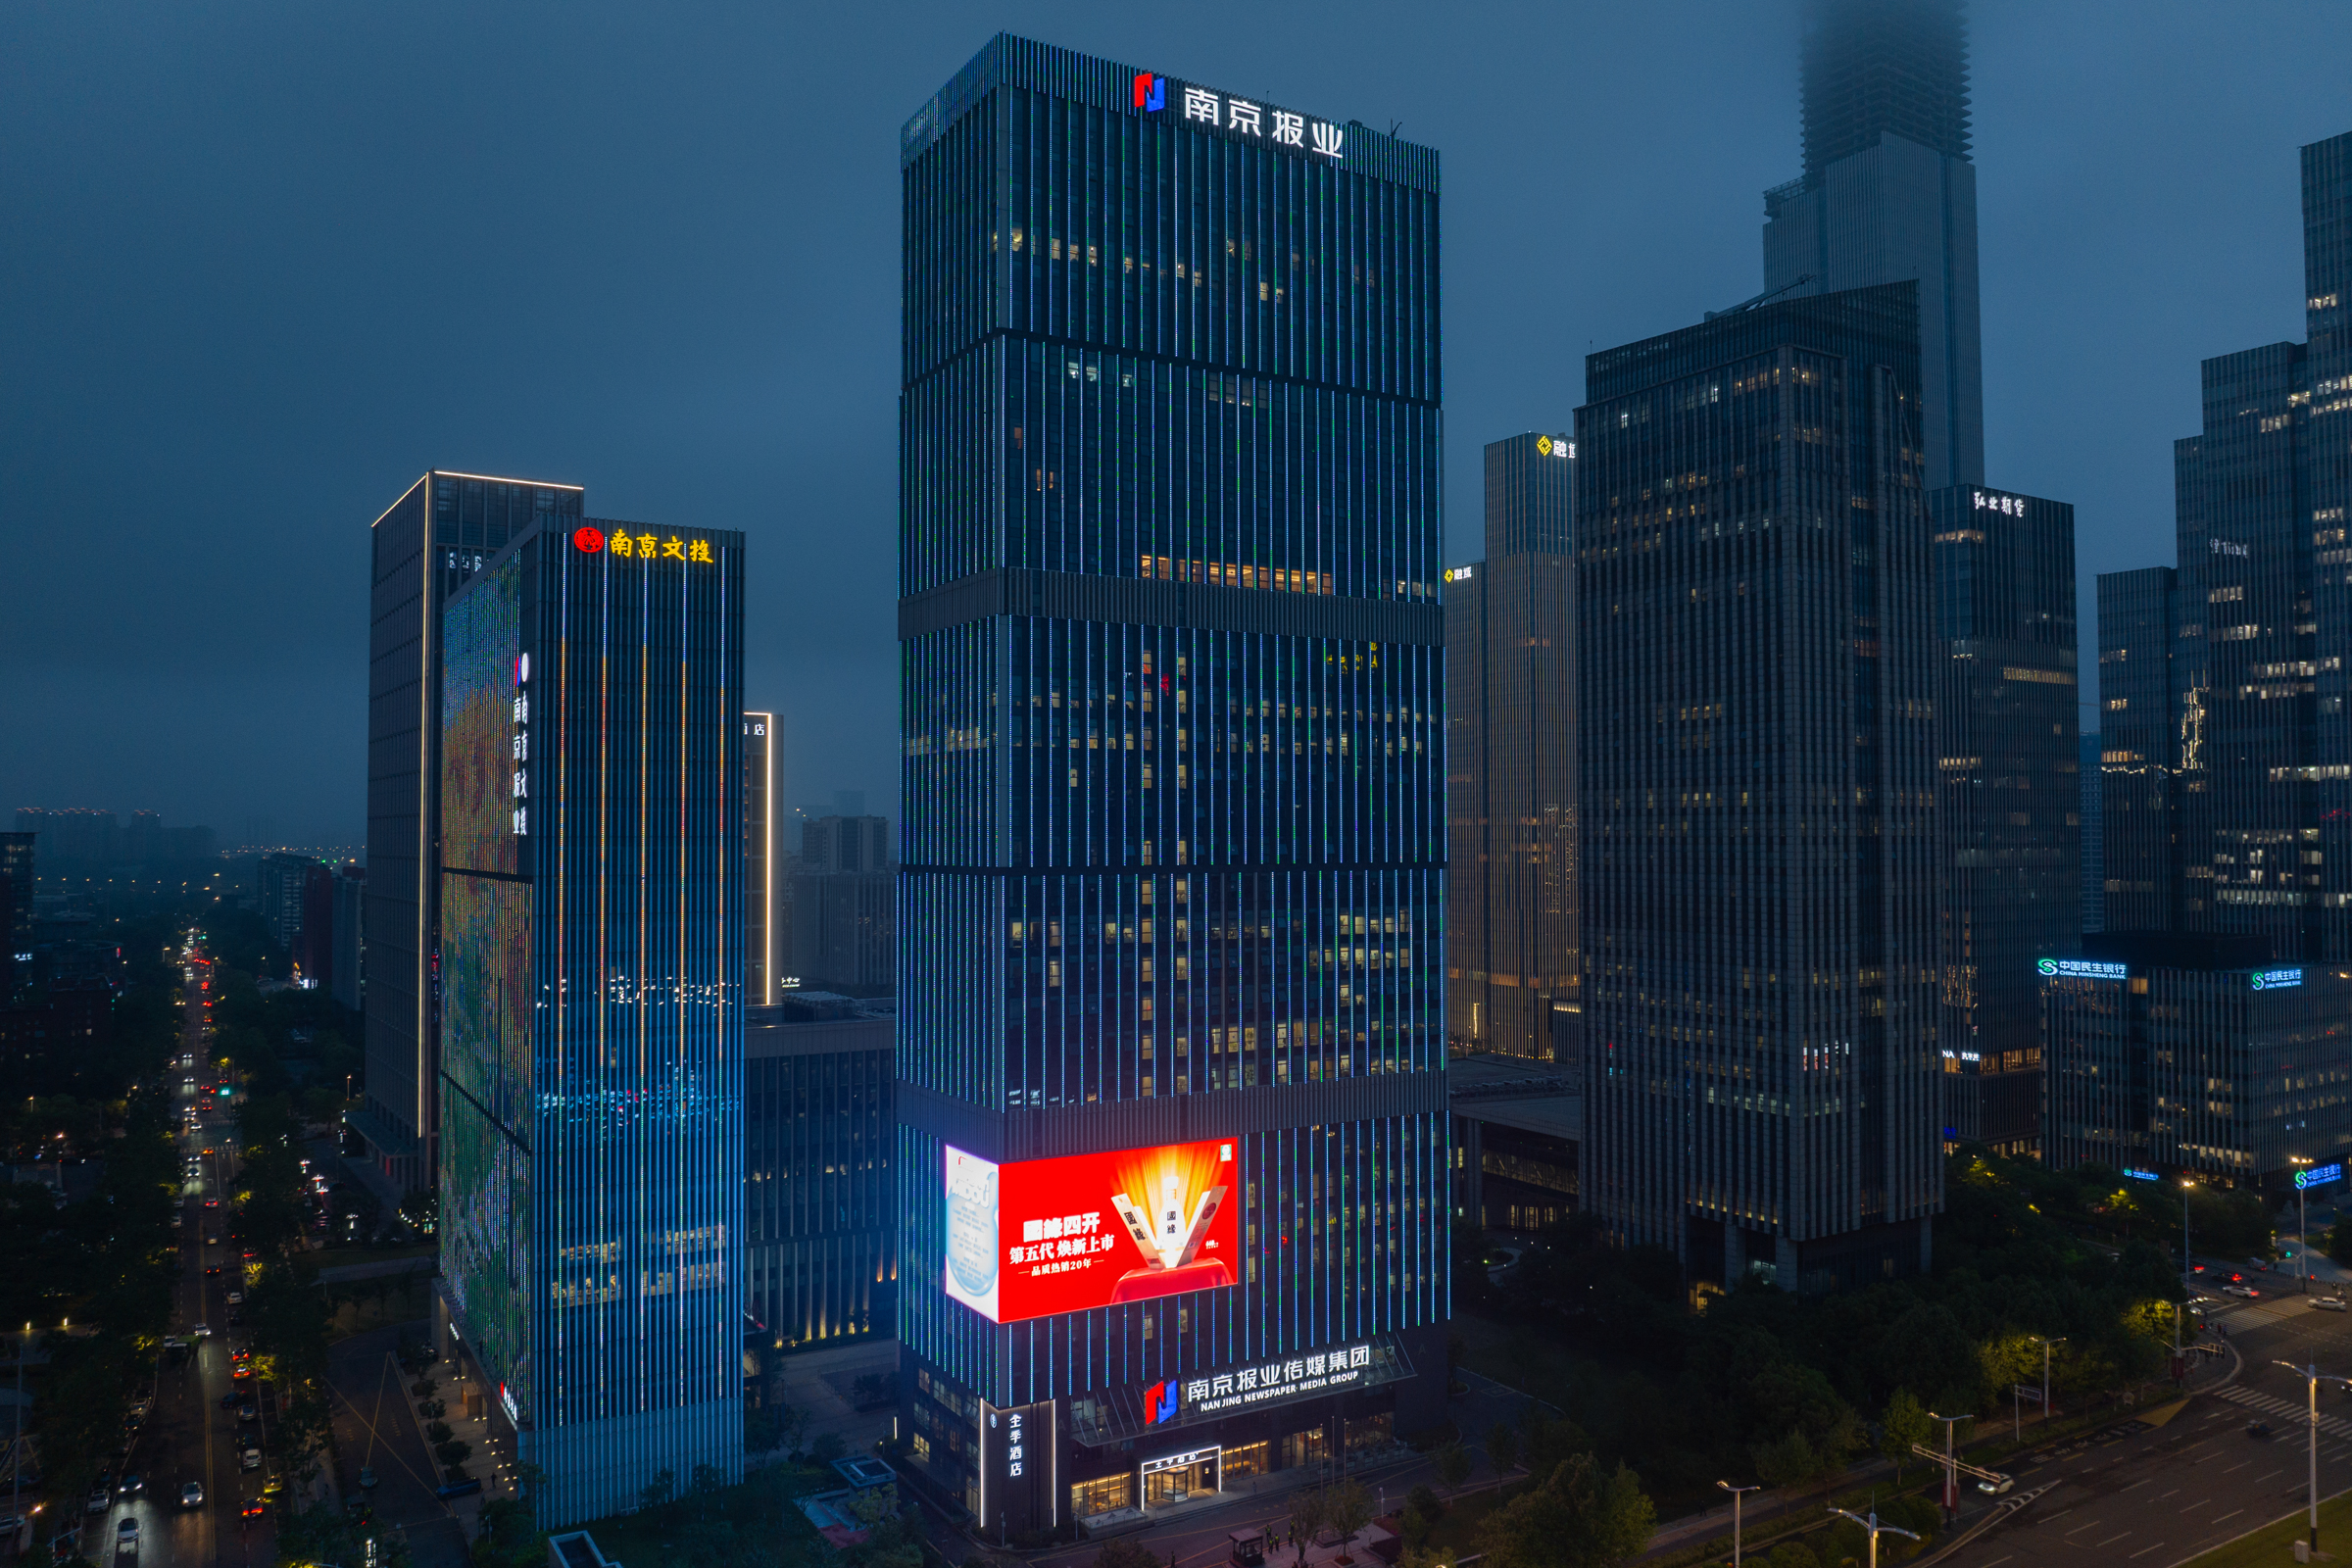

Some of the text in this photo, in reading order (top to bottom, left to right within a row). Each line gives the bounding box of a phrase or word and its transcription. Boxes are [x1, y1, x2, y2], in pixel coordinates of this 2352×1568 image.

[1185, 86, 1343, 159] 南京报业
[610, 528, 713, 564] 南京文投
[744, 722, 765, 736] 店
[2059, 960, 2127, 974] 中国民生银行
[2265, 969, 2301, 982] 中国民生银行
[1009, 1242, 1054, 1265] 第五代
[1188, 1345, 1370, 1403] 南京报业传媒集团
[1244, 1383, 1297, 1403] NEWSPAPER
[1299, 1377, 1327, 1392] MEDIA
[1330, 1370, 1358, 1385] GROUP
[1008, 1413, 1022, 1478] 全季酒店
